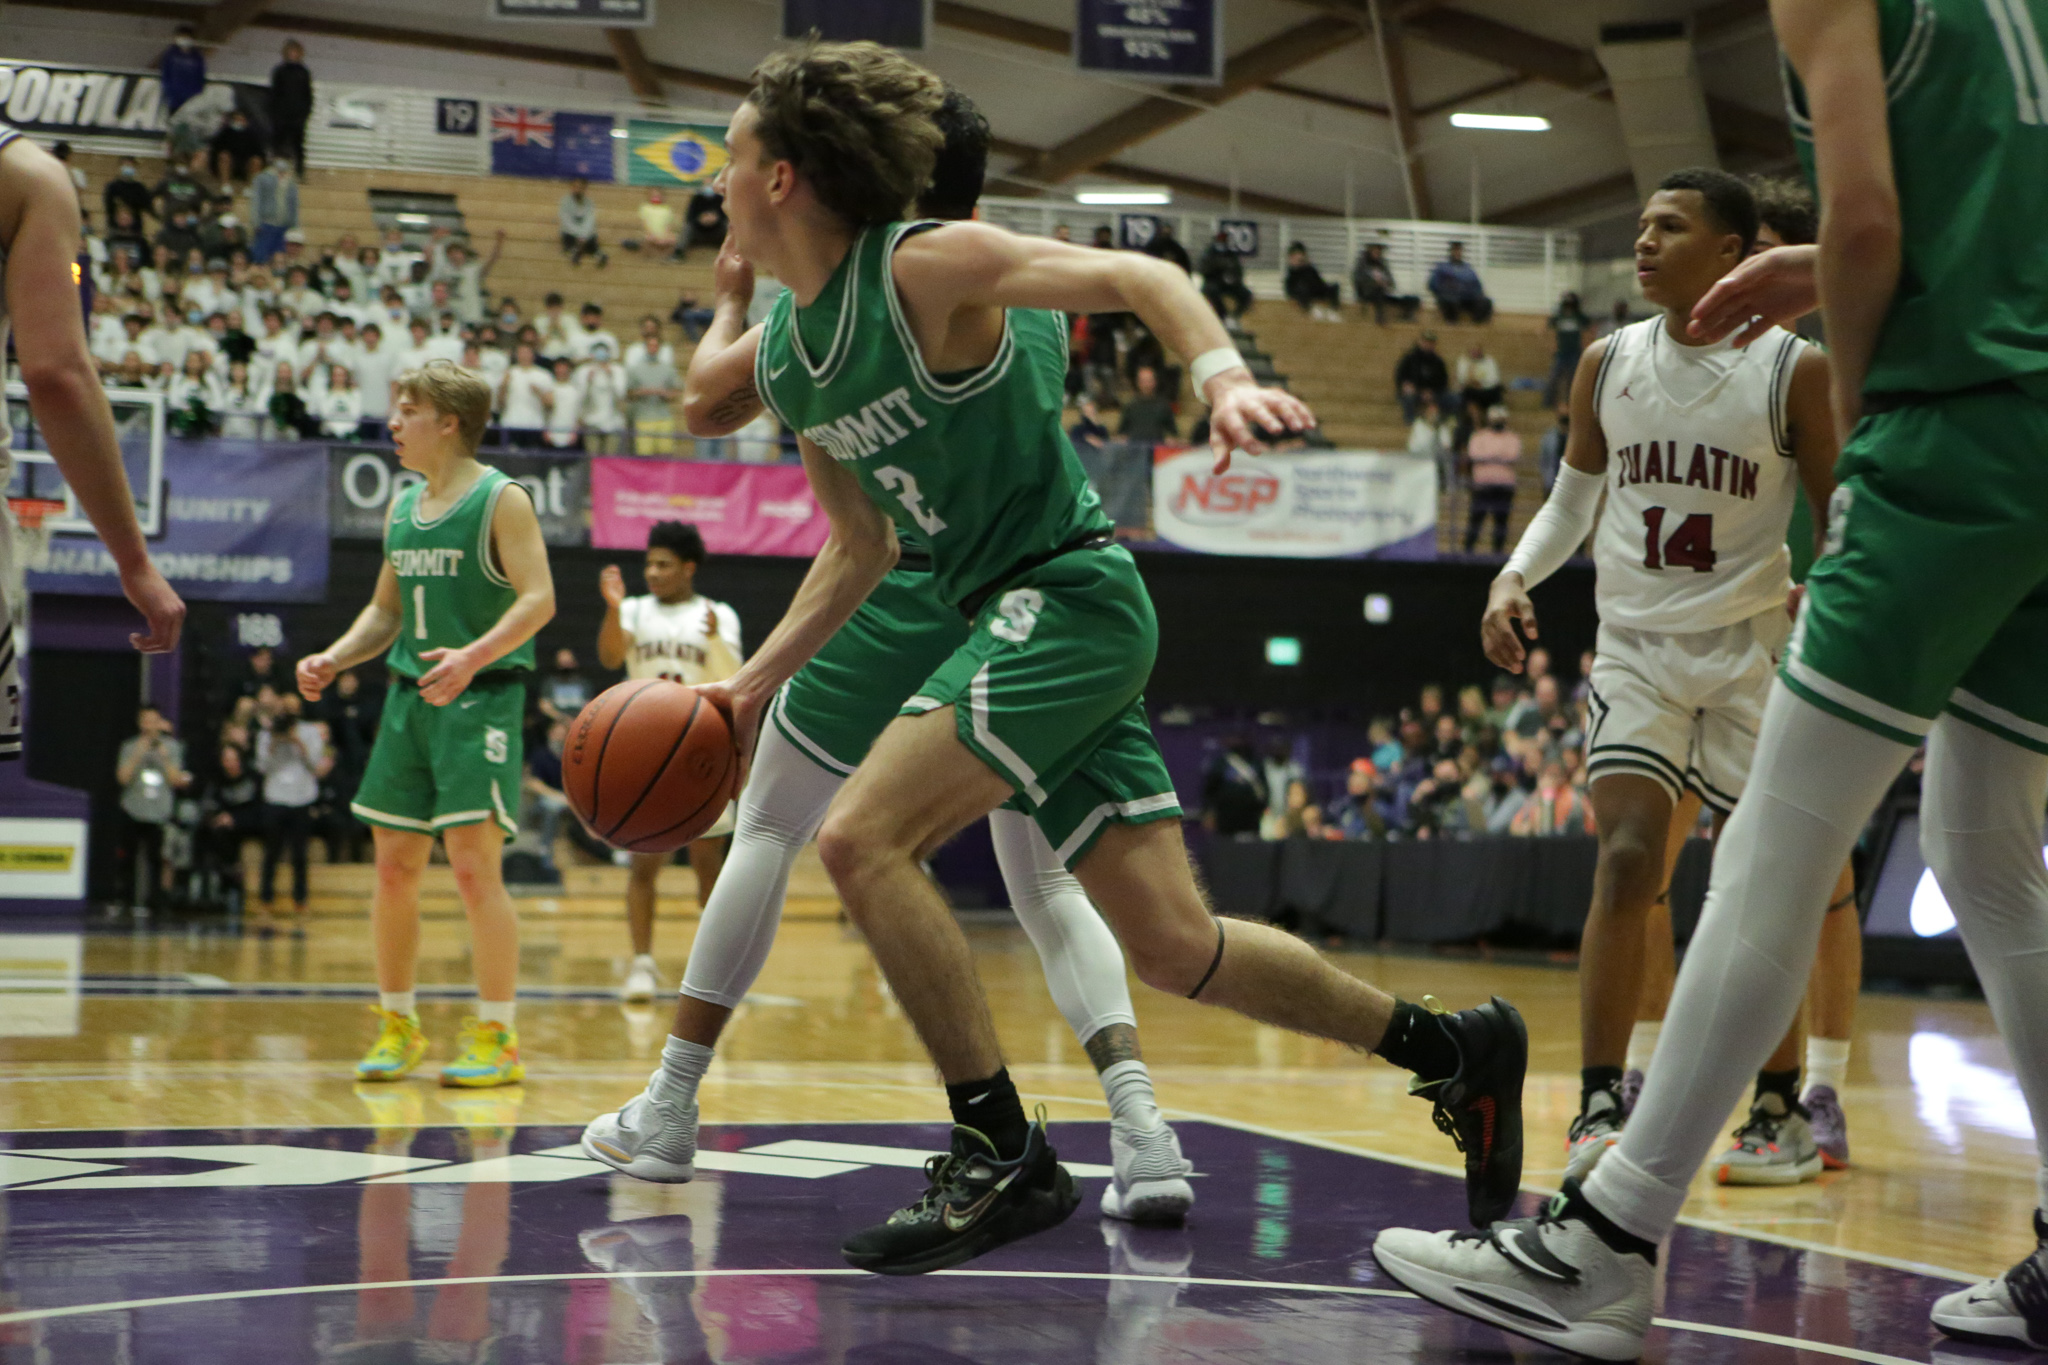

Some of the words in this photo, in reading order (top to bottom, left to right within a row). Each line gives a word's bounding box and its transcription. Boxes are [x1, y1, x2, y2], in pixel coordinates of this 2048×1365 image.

[0, 68, 168, 132] ORTLA
[444, 102, 474, 130] 19
[1126, 217, 1155, 247] 19
[803, 387, 928, 460] SUMMIT
[1175, 473, 1280, 515] NSP
[1617, 440, 1760, 501] TUALATIN
[873, 465, 948, 536] 2
[391, 549, 464, 577] SUMMIT
[1642, 506, 1716, 573] 14
[413, 584, 428, 639] 1
[989, 588, 1044, 642] S
[484, 726, 508, 764] S
